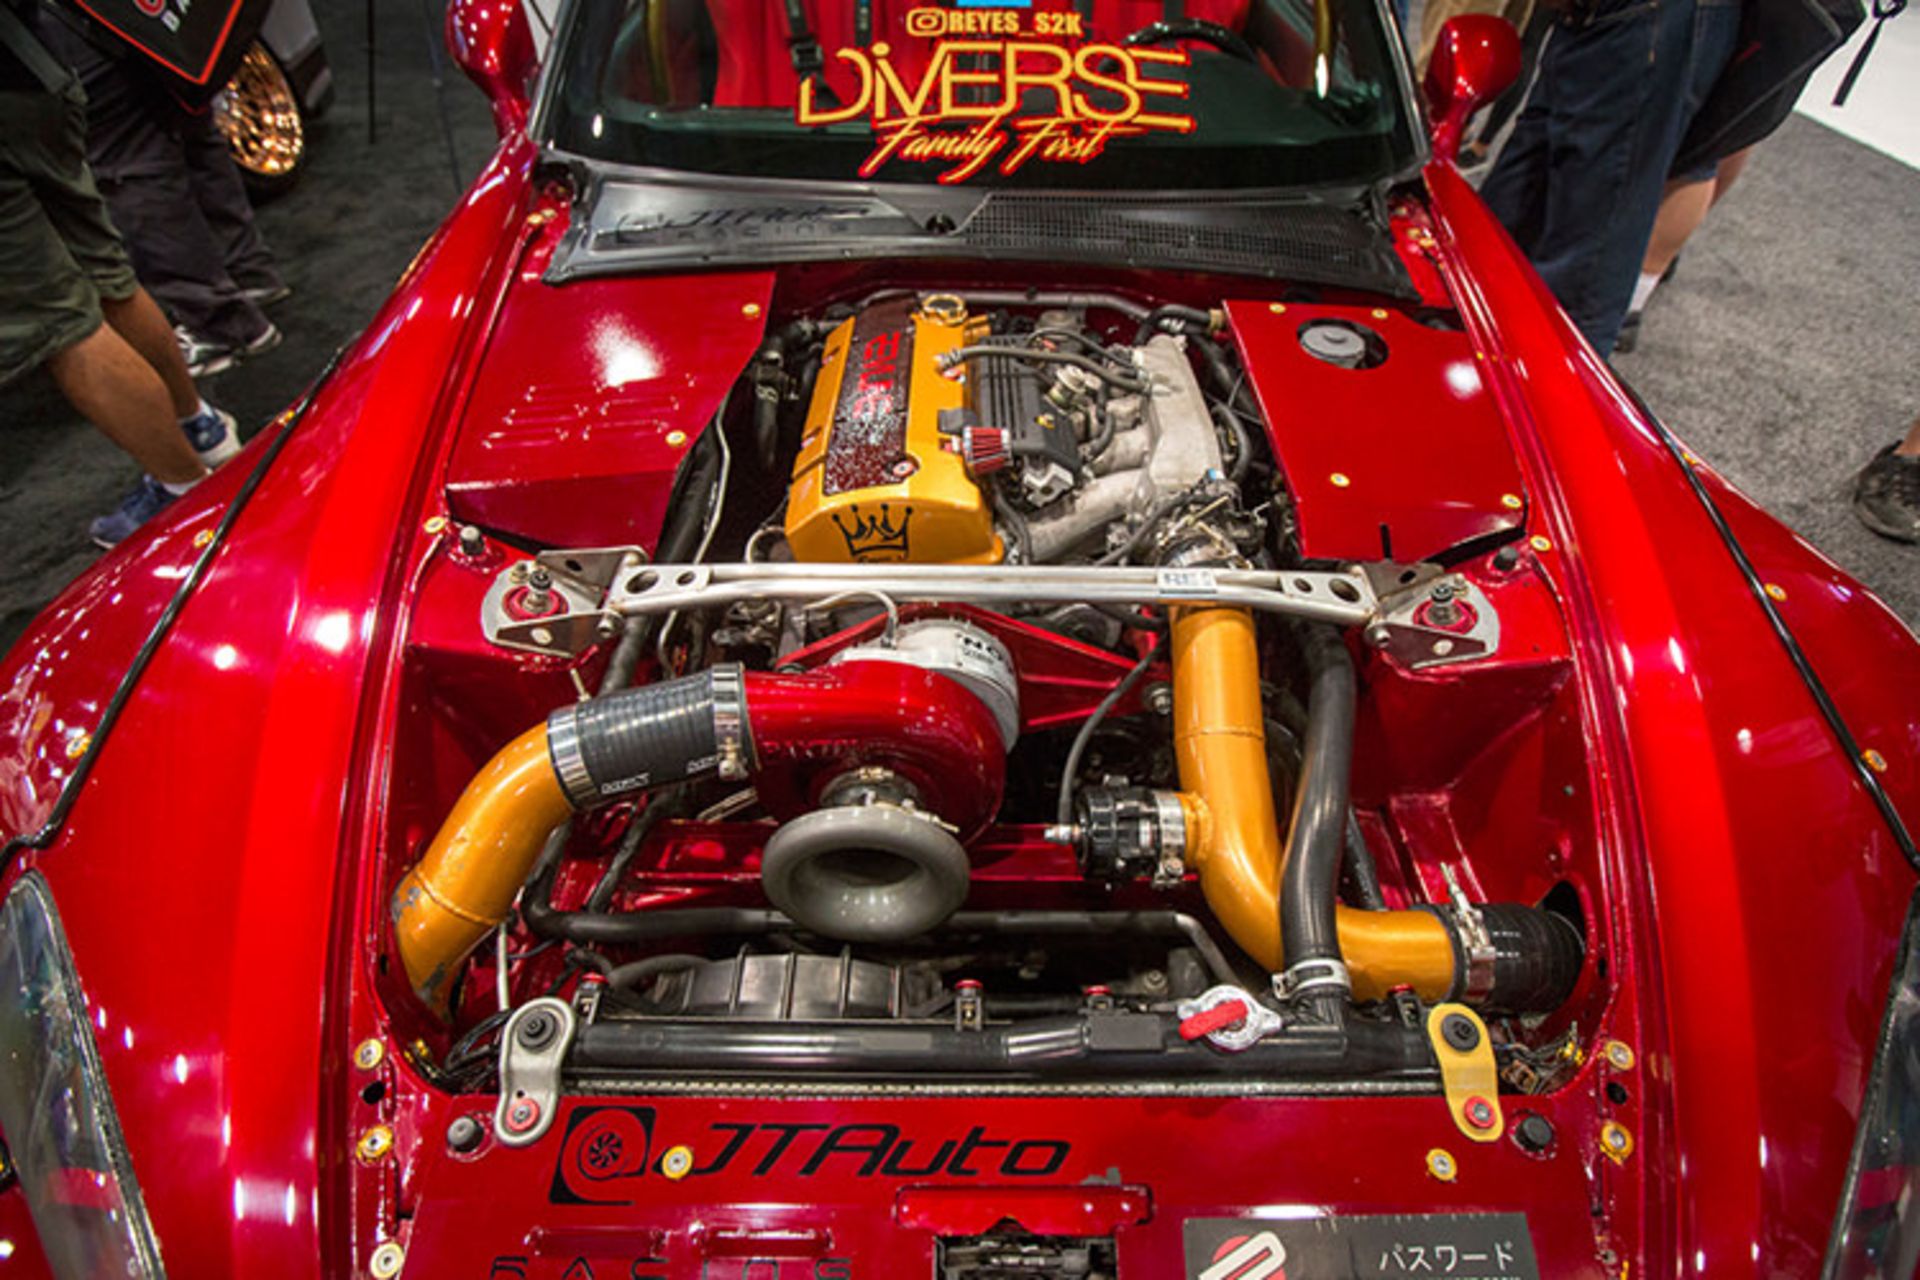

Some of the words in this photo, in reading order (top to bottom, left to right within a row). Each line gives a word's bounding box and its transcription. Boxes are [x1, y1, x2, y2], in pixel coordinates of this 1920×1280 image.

[948, 9, 1083, 36] REYES_S2K
[858, 113, 1006, 184] Family
[1000, 115, 1146, 176] First
[653, 1122, 1072, 1177] JTAuto
[1379, 1240, 1514, 1272] パスワード
